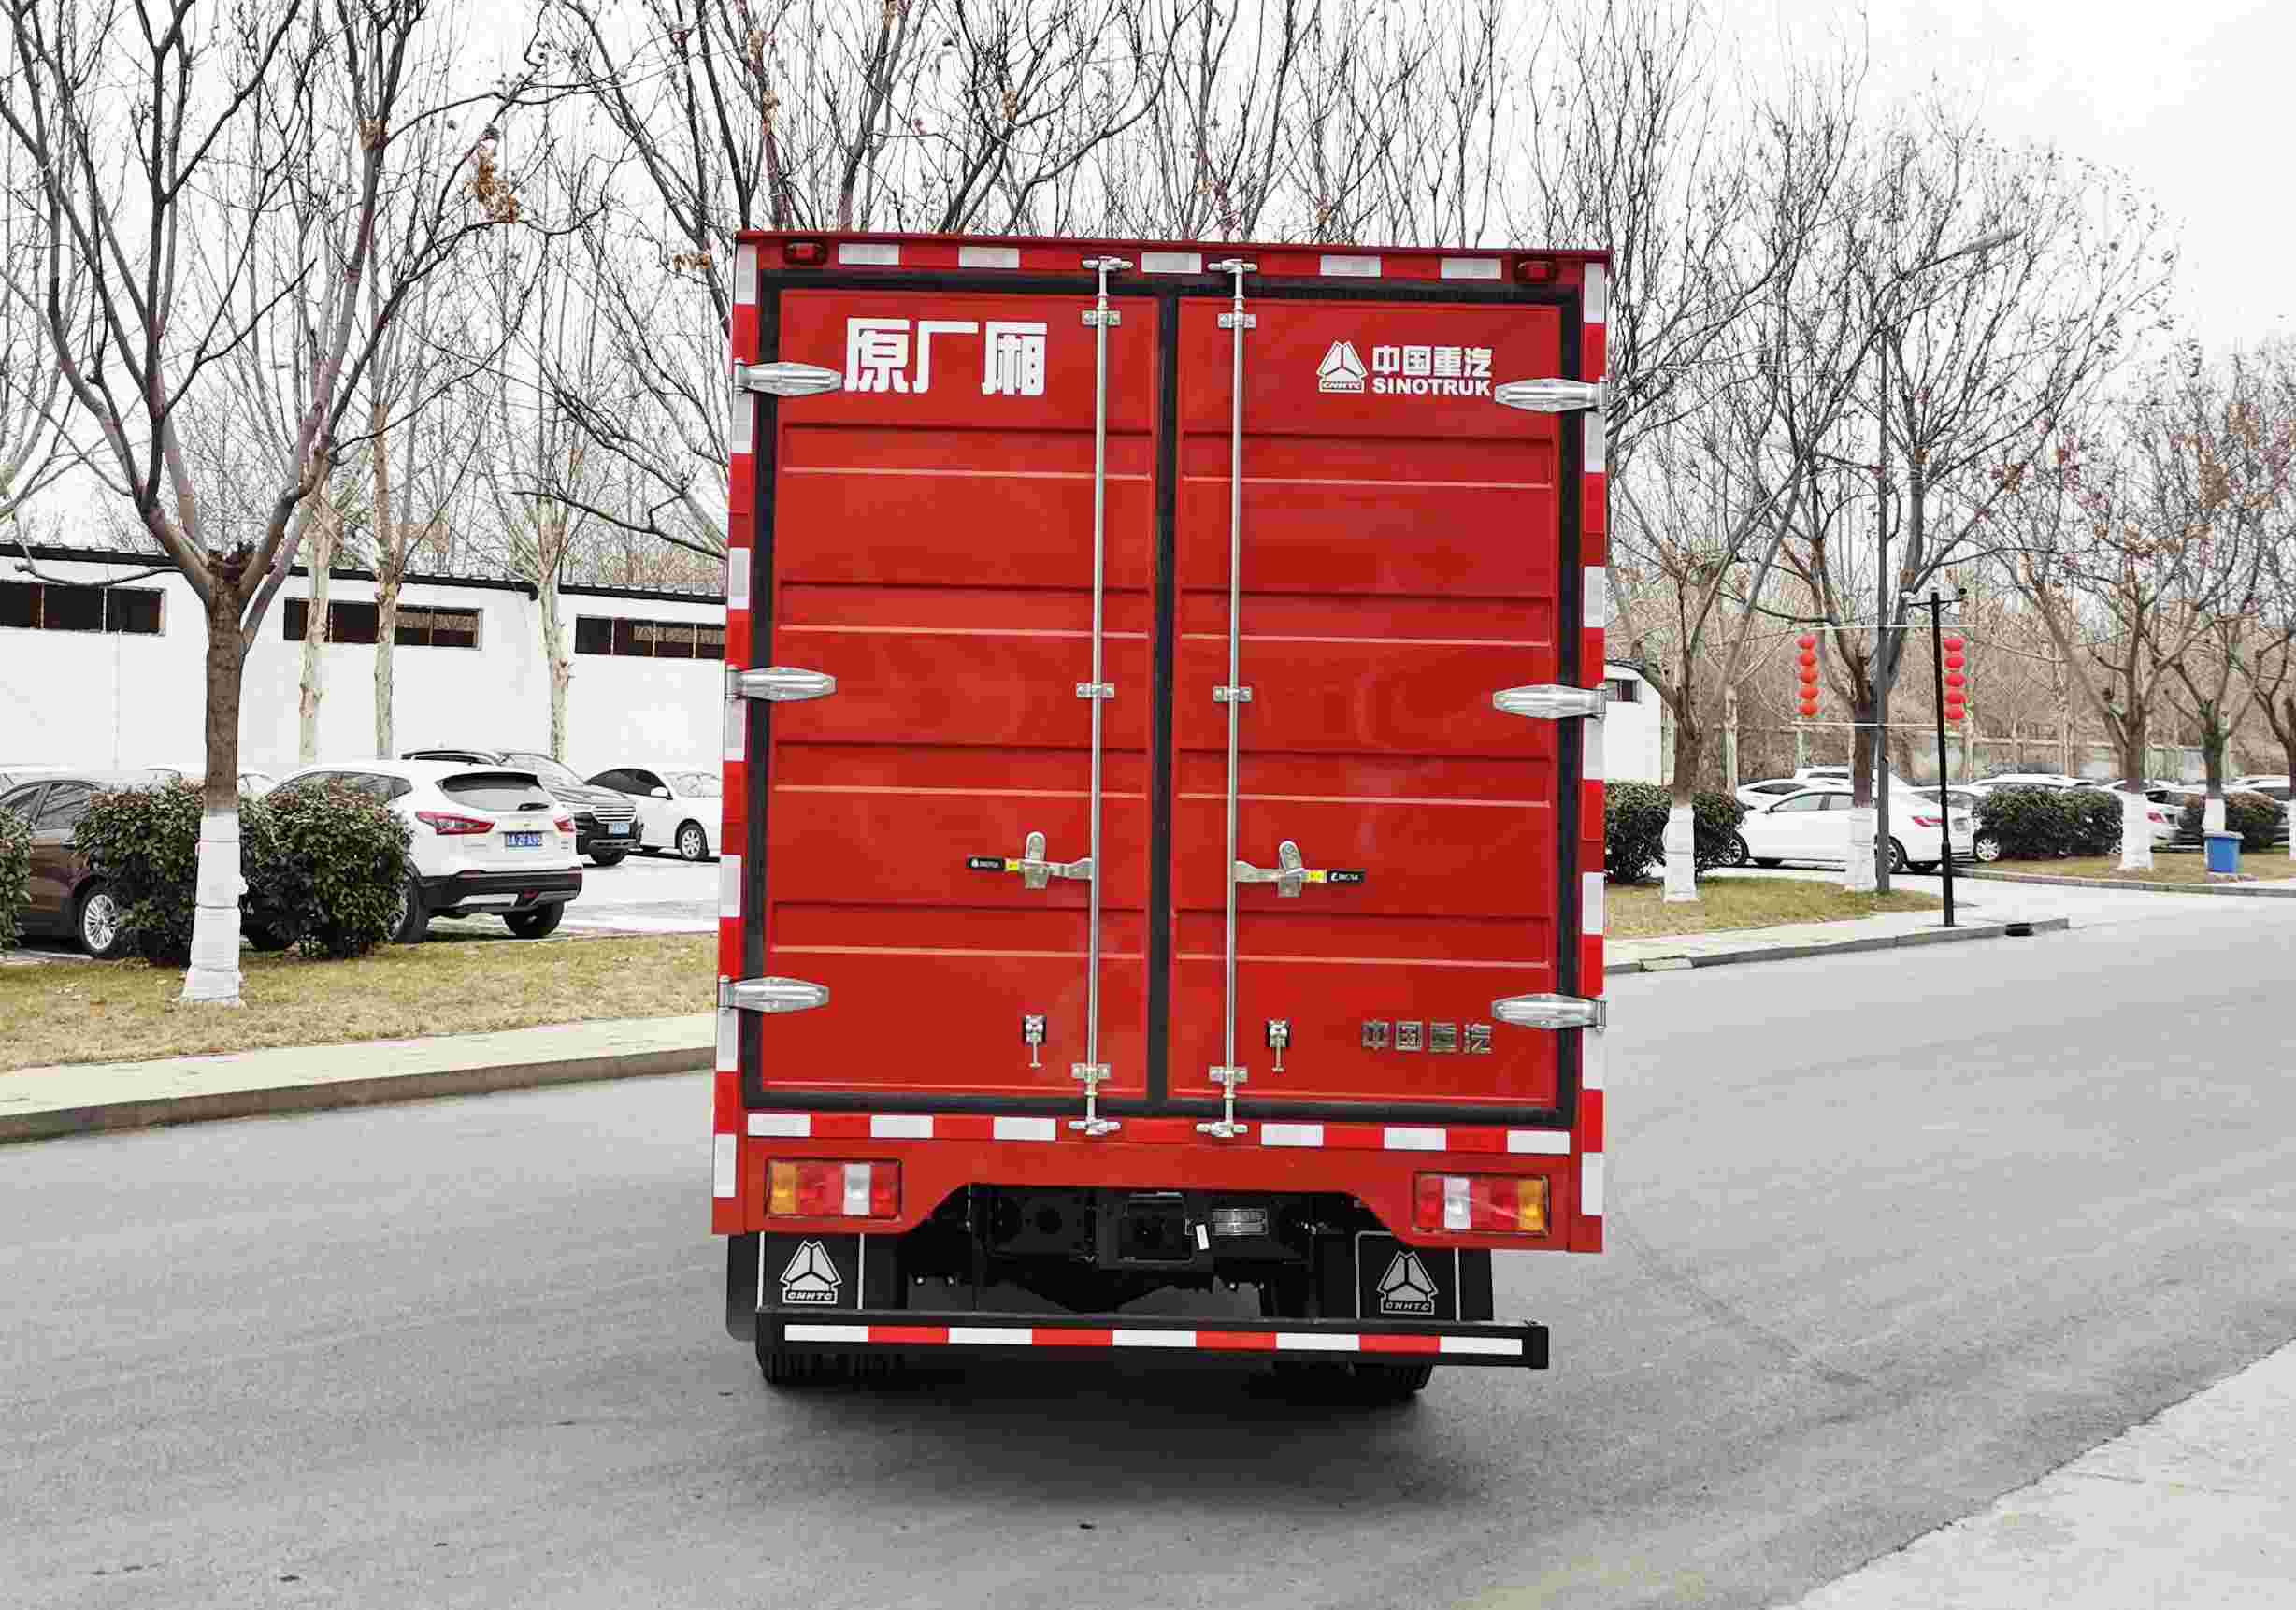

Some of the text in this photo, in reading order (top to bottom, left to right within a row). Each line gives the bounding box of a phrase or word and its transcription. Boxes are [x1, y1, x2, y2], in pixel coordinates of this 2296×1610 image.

[1371, 345, 1493, 377] 中国重汽
[1371, 377, 1491, 396] SINOTRUK
